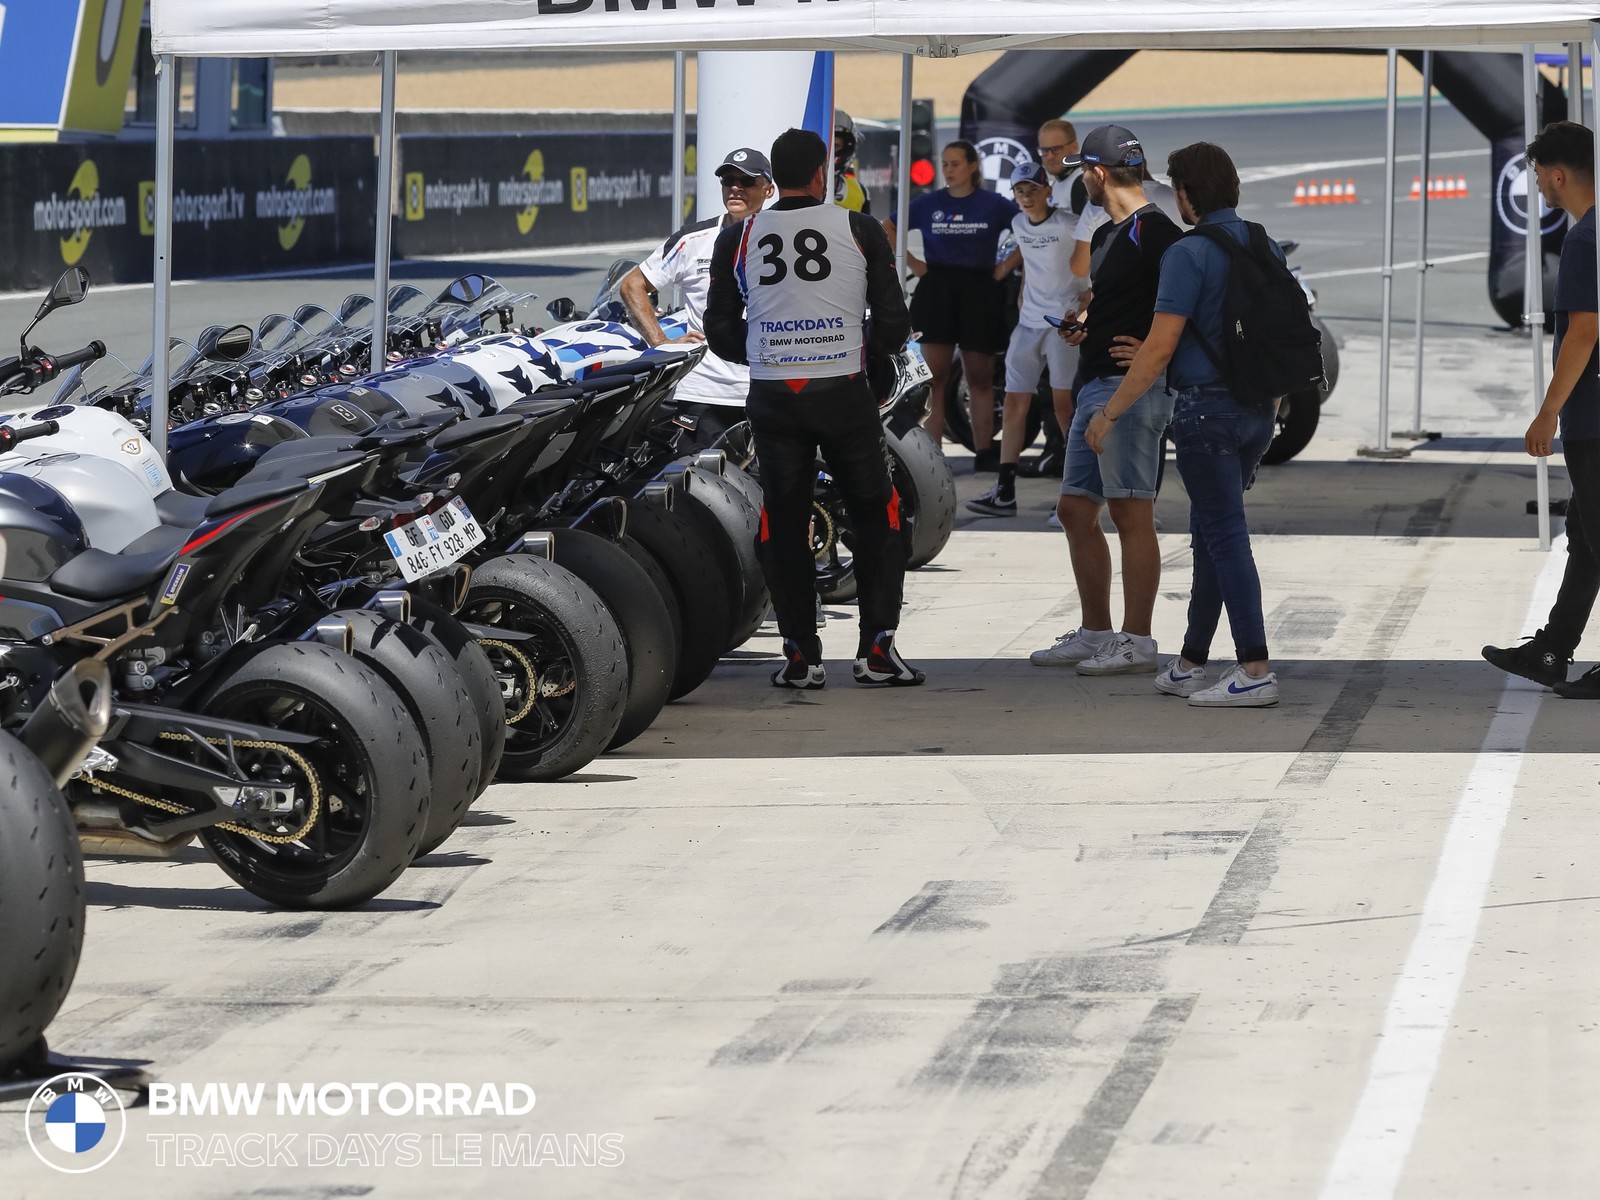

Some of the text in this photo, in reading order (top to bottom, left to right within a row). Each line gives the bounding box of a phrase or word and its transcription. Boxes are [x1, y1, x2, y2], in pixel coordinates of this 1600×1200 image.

[173, 186, 245, 230] otorsport.tv
[256, 184, 335, 225] motorsport.com
[425, 177, 489, 216] motorsport.tv
[498, 176, 564, 212] motorsport.com
[587, 168, 651, 208] motorsport.tv
[34, 191, 126, 238] motorsport.com
[758, 228, 831, 286] 38
[760, 317, 844, 333] TRACKDAYS
[769, 334, 845, 346] BMW MOTORRAD
